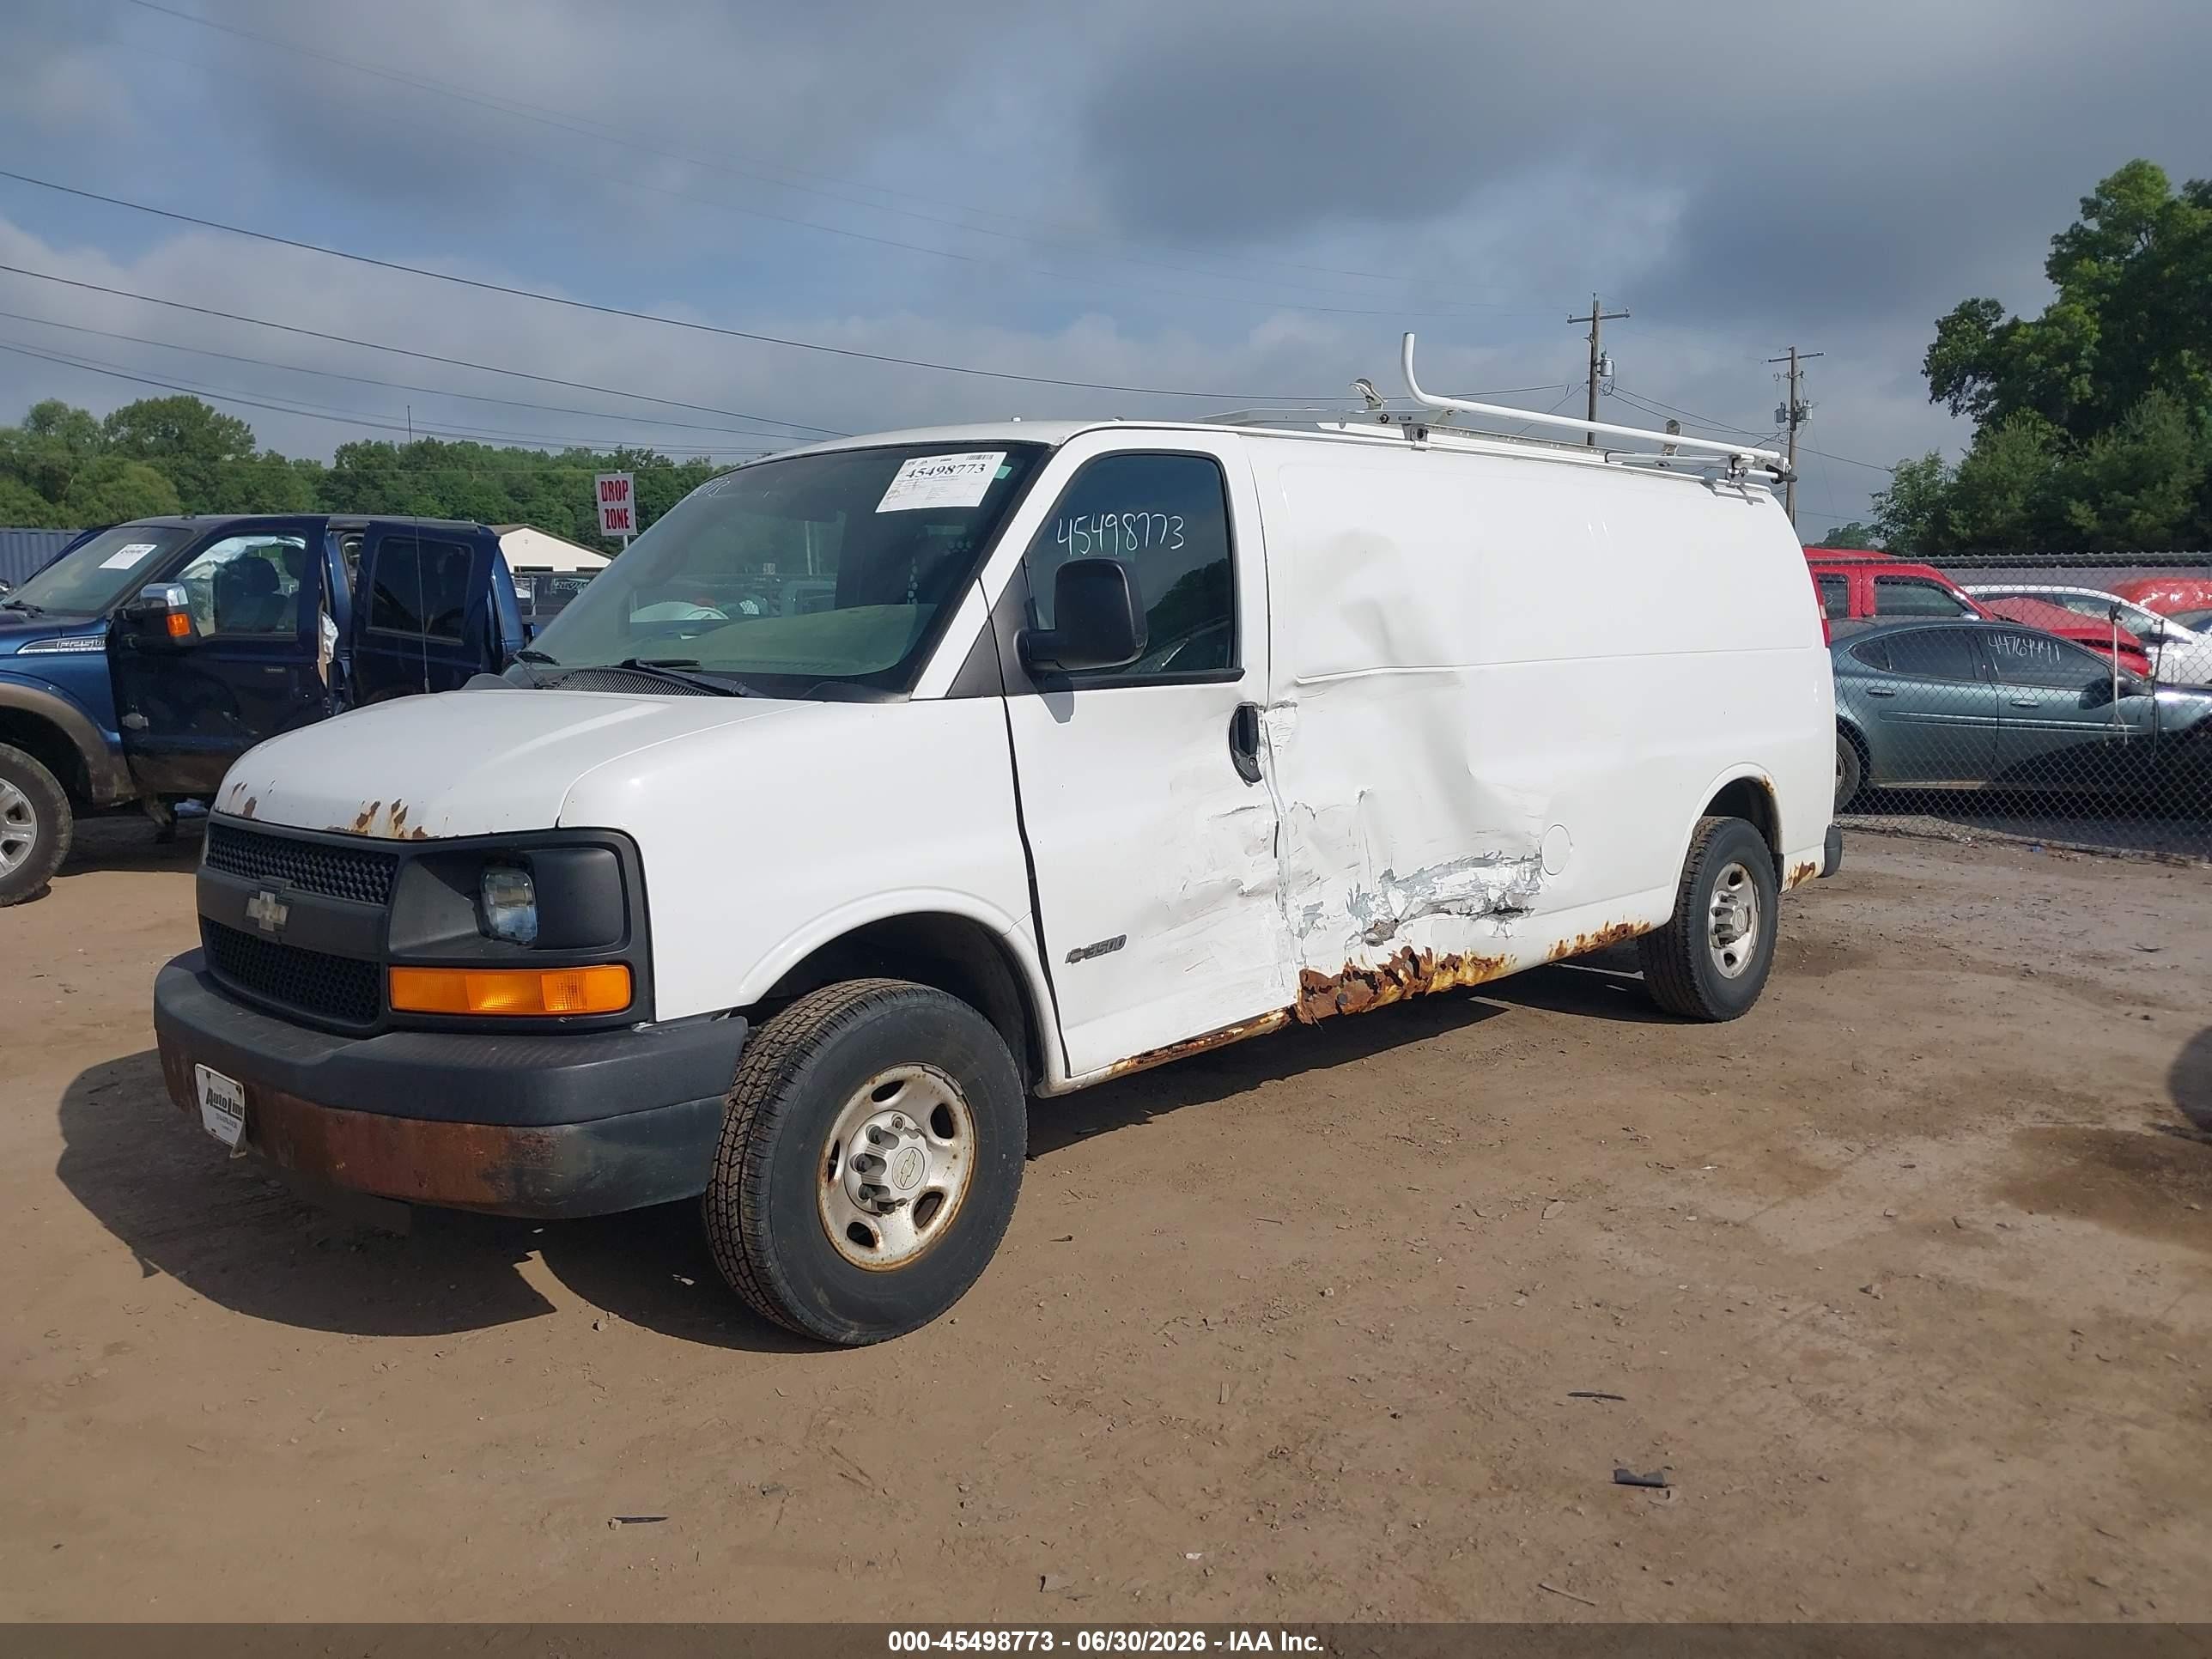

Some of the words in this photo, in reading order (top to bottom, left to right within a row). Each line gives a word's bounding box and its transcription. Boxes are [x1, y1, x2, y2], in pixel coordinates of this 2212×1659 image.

[906, 463, 986, 478] 45498773
[601, 480, 629, 501] DROP
[605, 508, 630, 529] ZONE
[1057, 513, 1184, 556] 45498773
